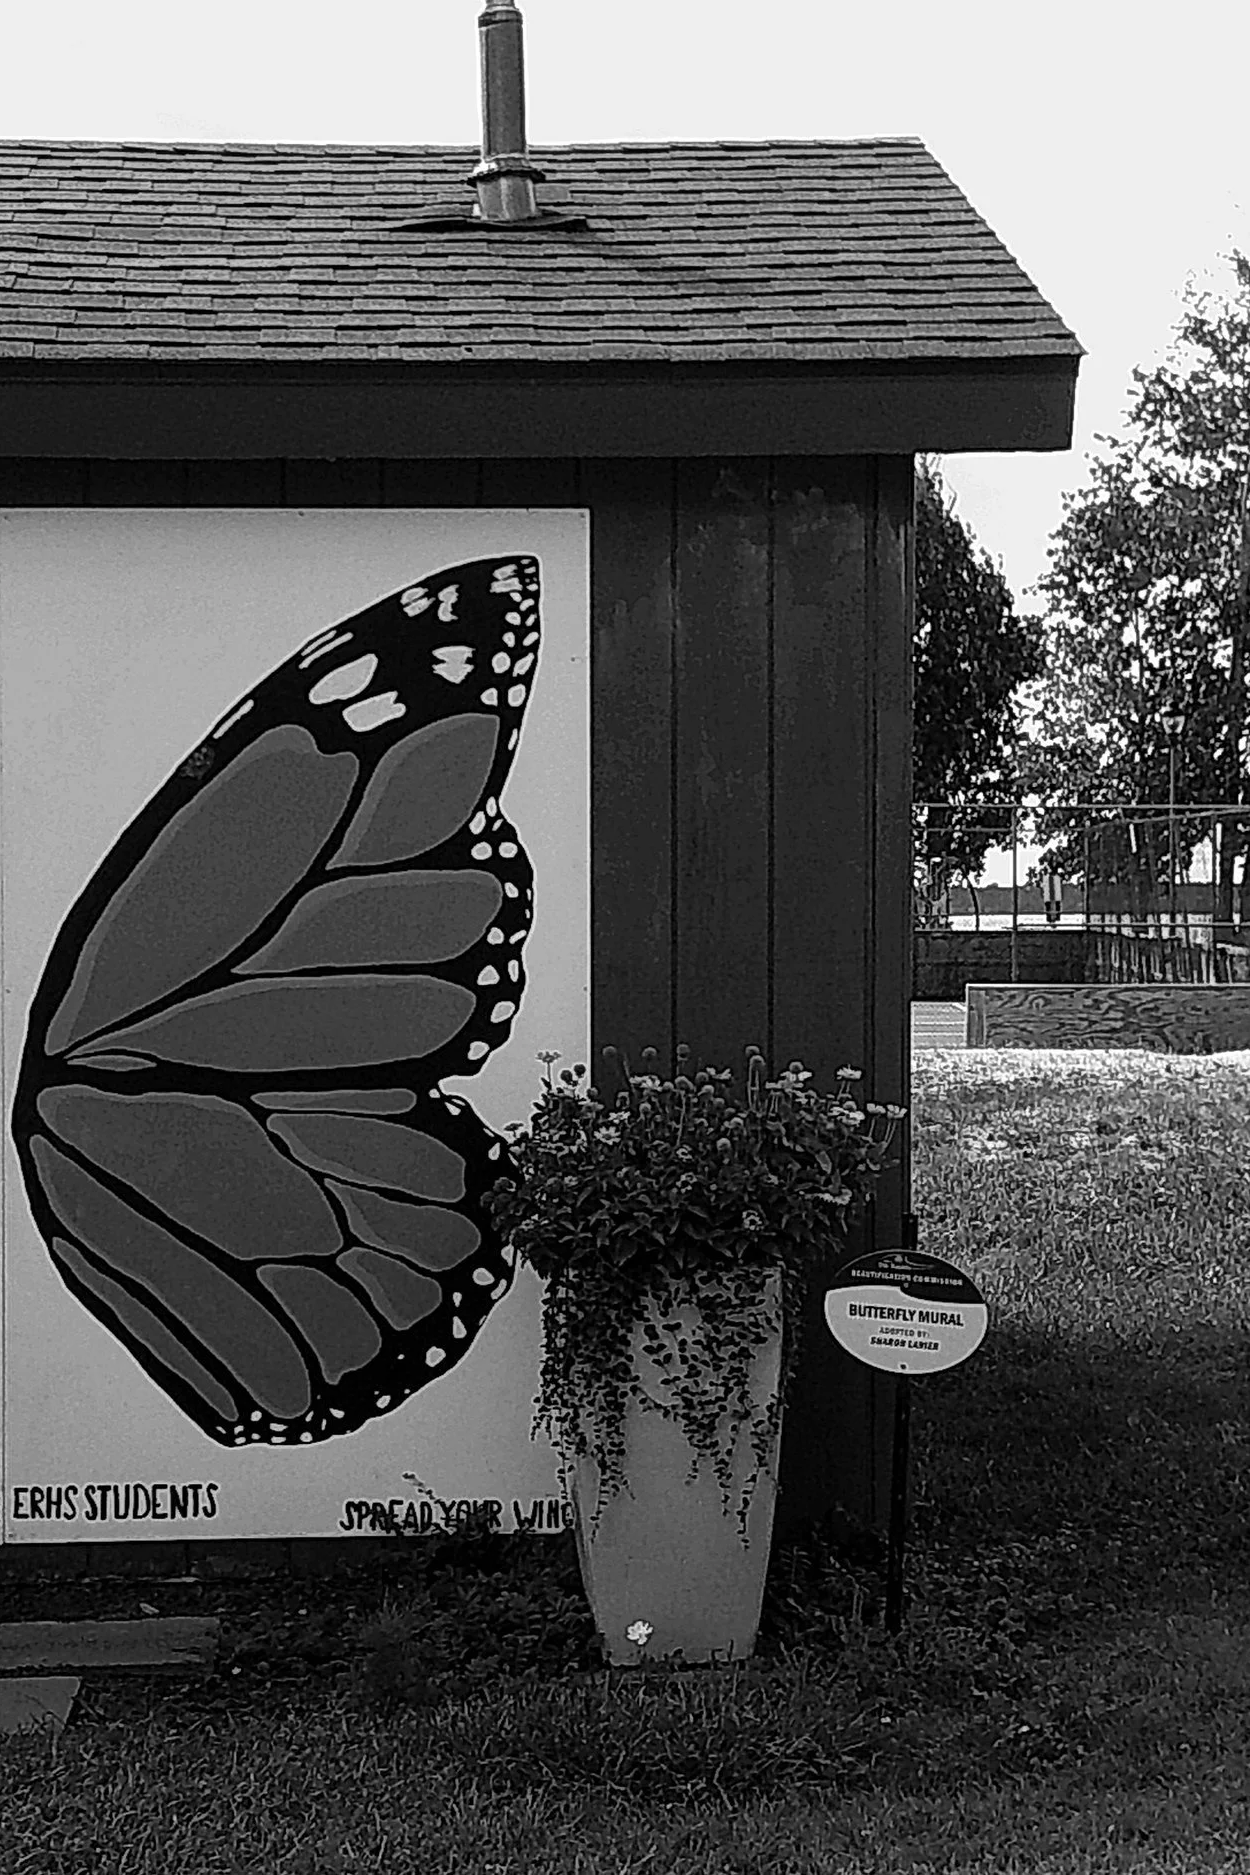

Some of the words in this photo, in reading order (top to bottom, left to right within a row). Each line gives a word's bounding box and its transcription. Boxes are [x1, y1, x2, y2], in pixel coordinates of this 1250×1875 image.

[849, 1303, 916, 1322] BUTTERFLY
[918, 1310, 964, 1327] MURAL
[879, 1327, 915, 1337] ADOPTED
[13, 1485, 79, 1520] ERHS
[84, 1483, 219, 1521] STUDENTS
[339, 1499, 432, 1533] SPREAD
[513, 1500, 574, 1529] WING
